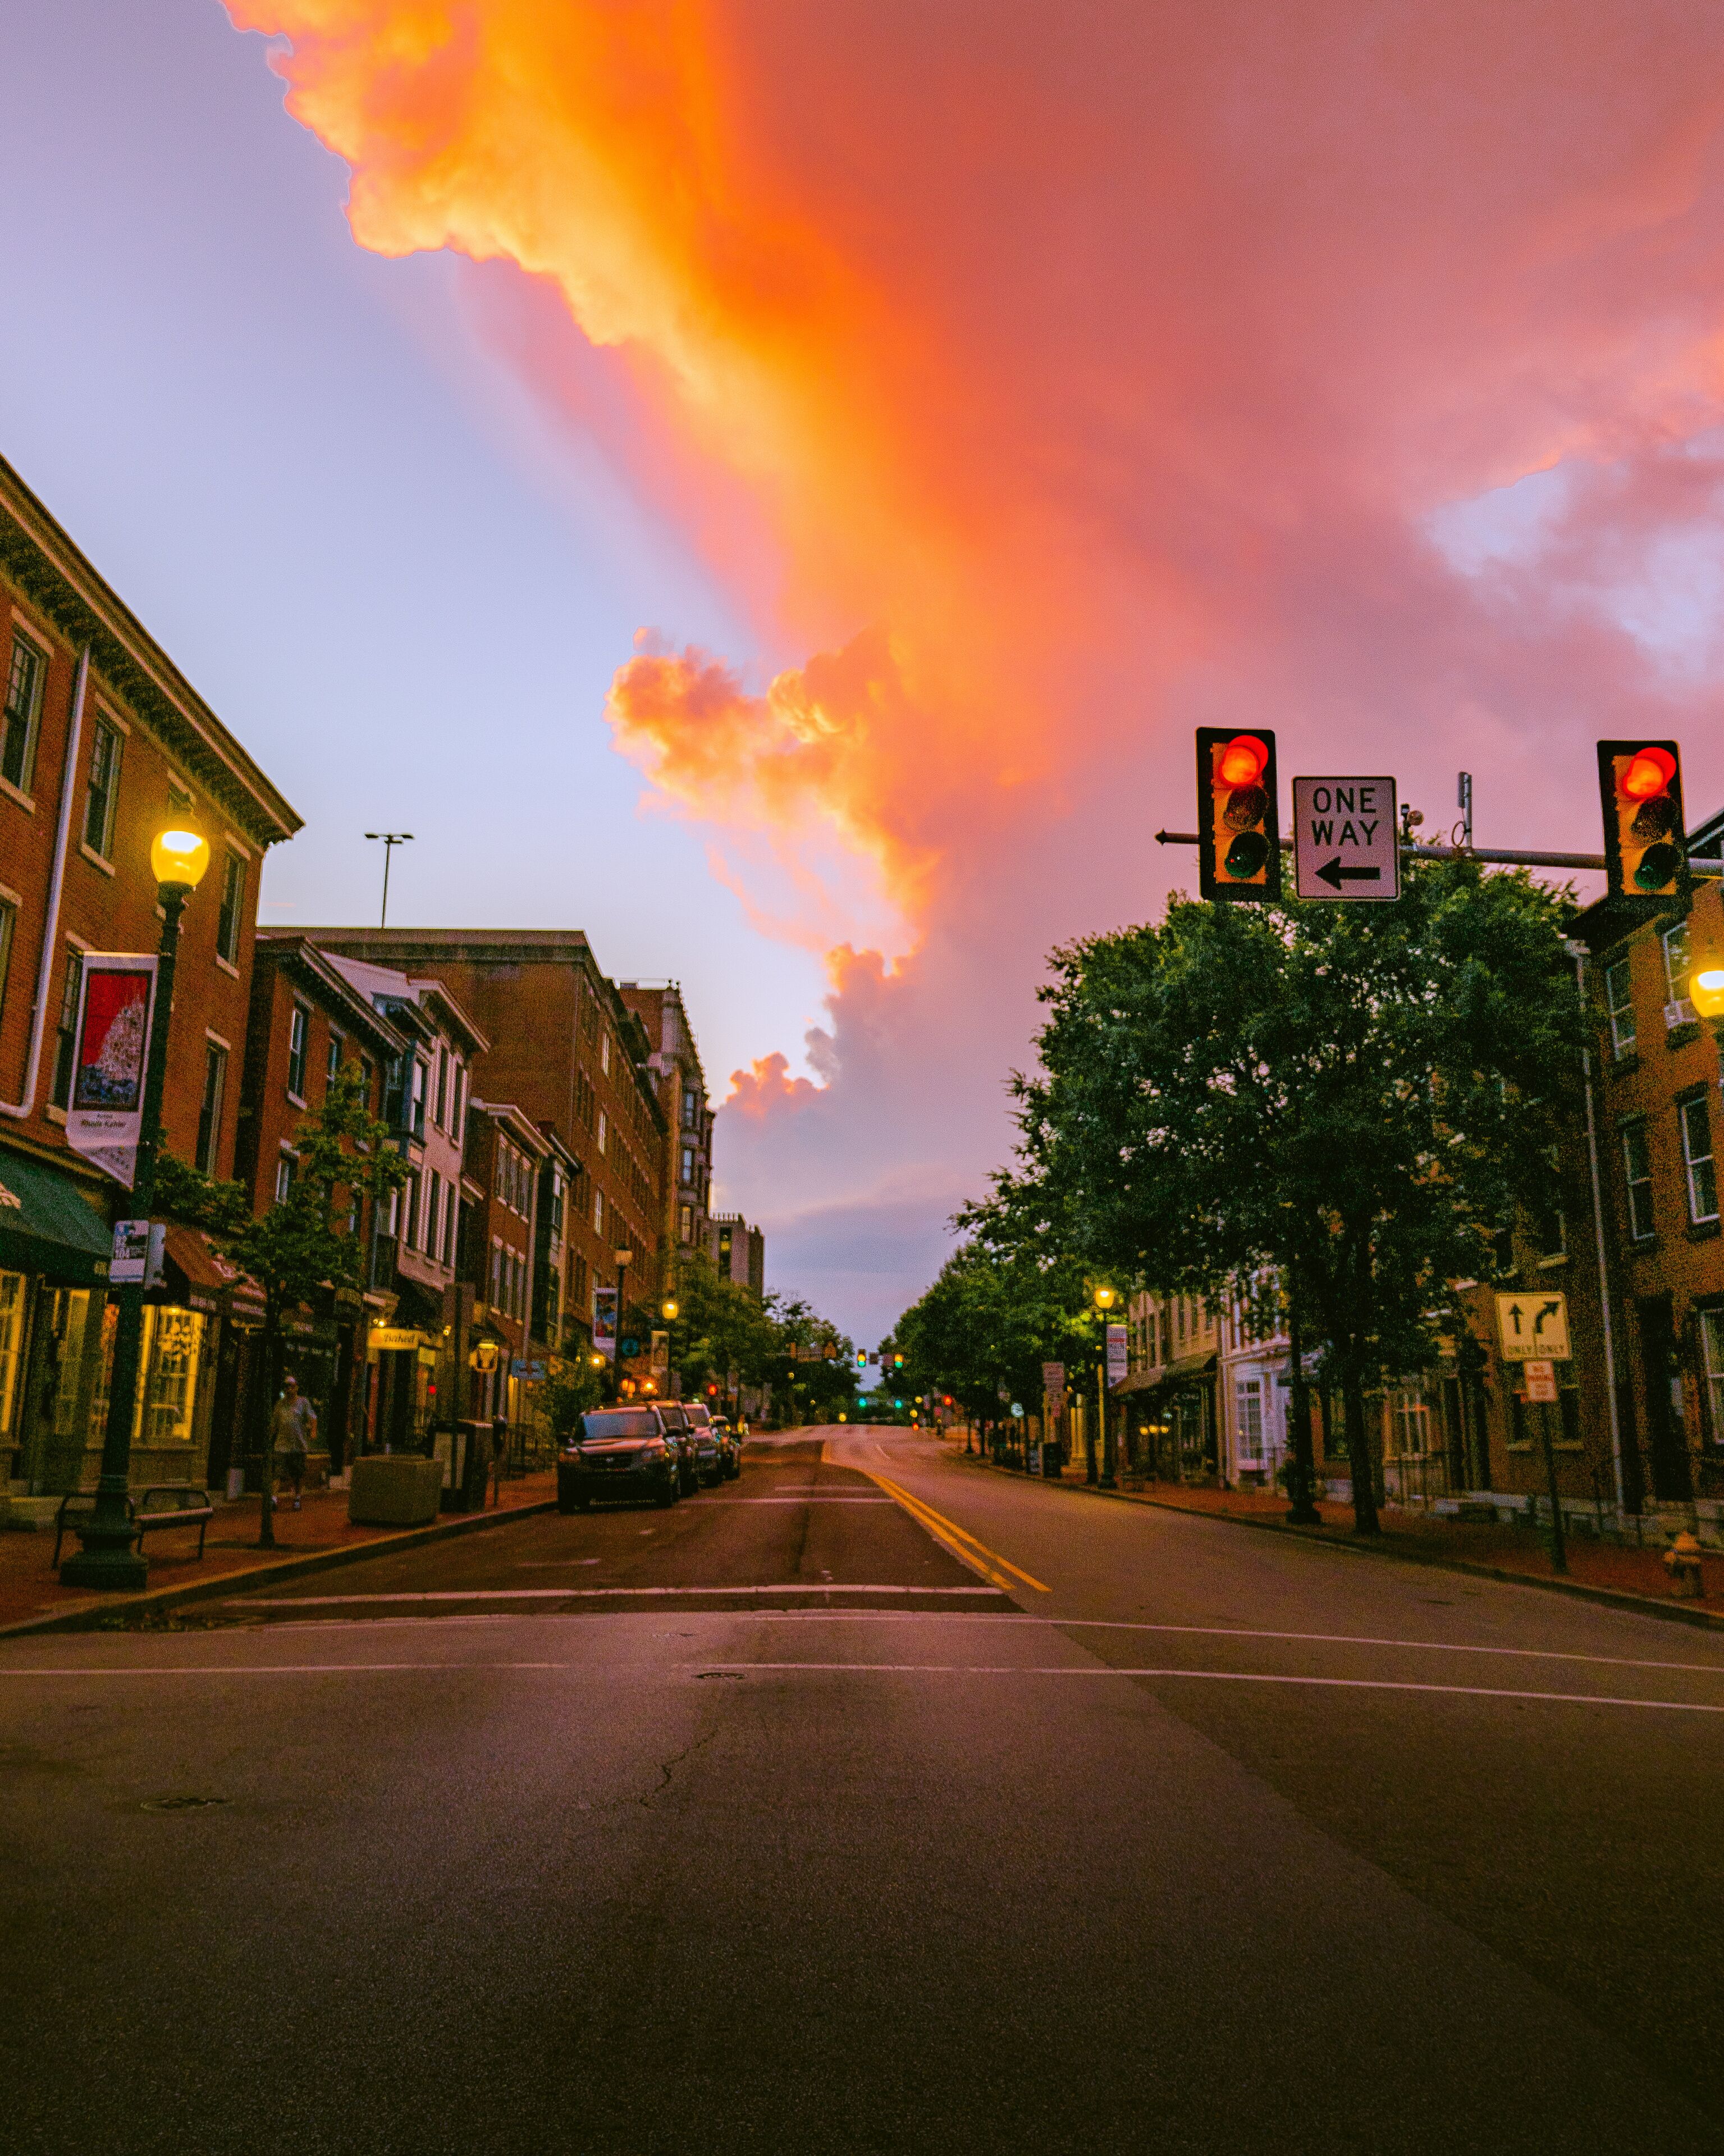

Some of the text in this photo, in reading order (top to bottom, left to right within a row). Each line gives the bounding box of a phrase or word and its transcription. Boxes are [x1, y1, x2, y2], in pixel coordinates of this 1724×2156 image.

[1313, 787, 1377, 814] ONE
[1311, 820, 1379, 846] WAY
[384, 1332, 415, 1343] Baked
[1507, 1345, 1565, 1354] ONLY ONLY
